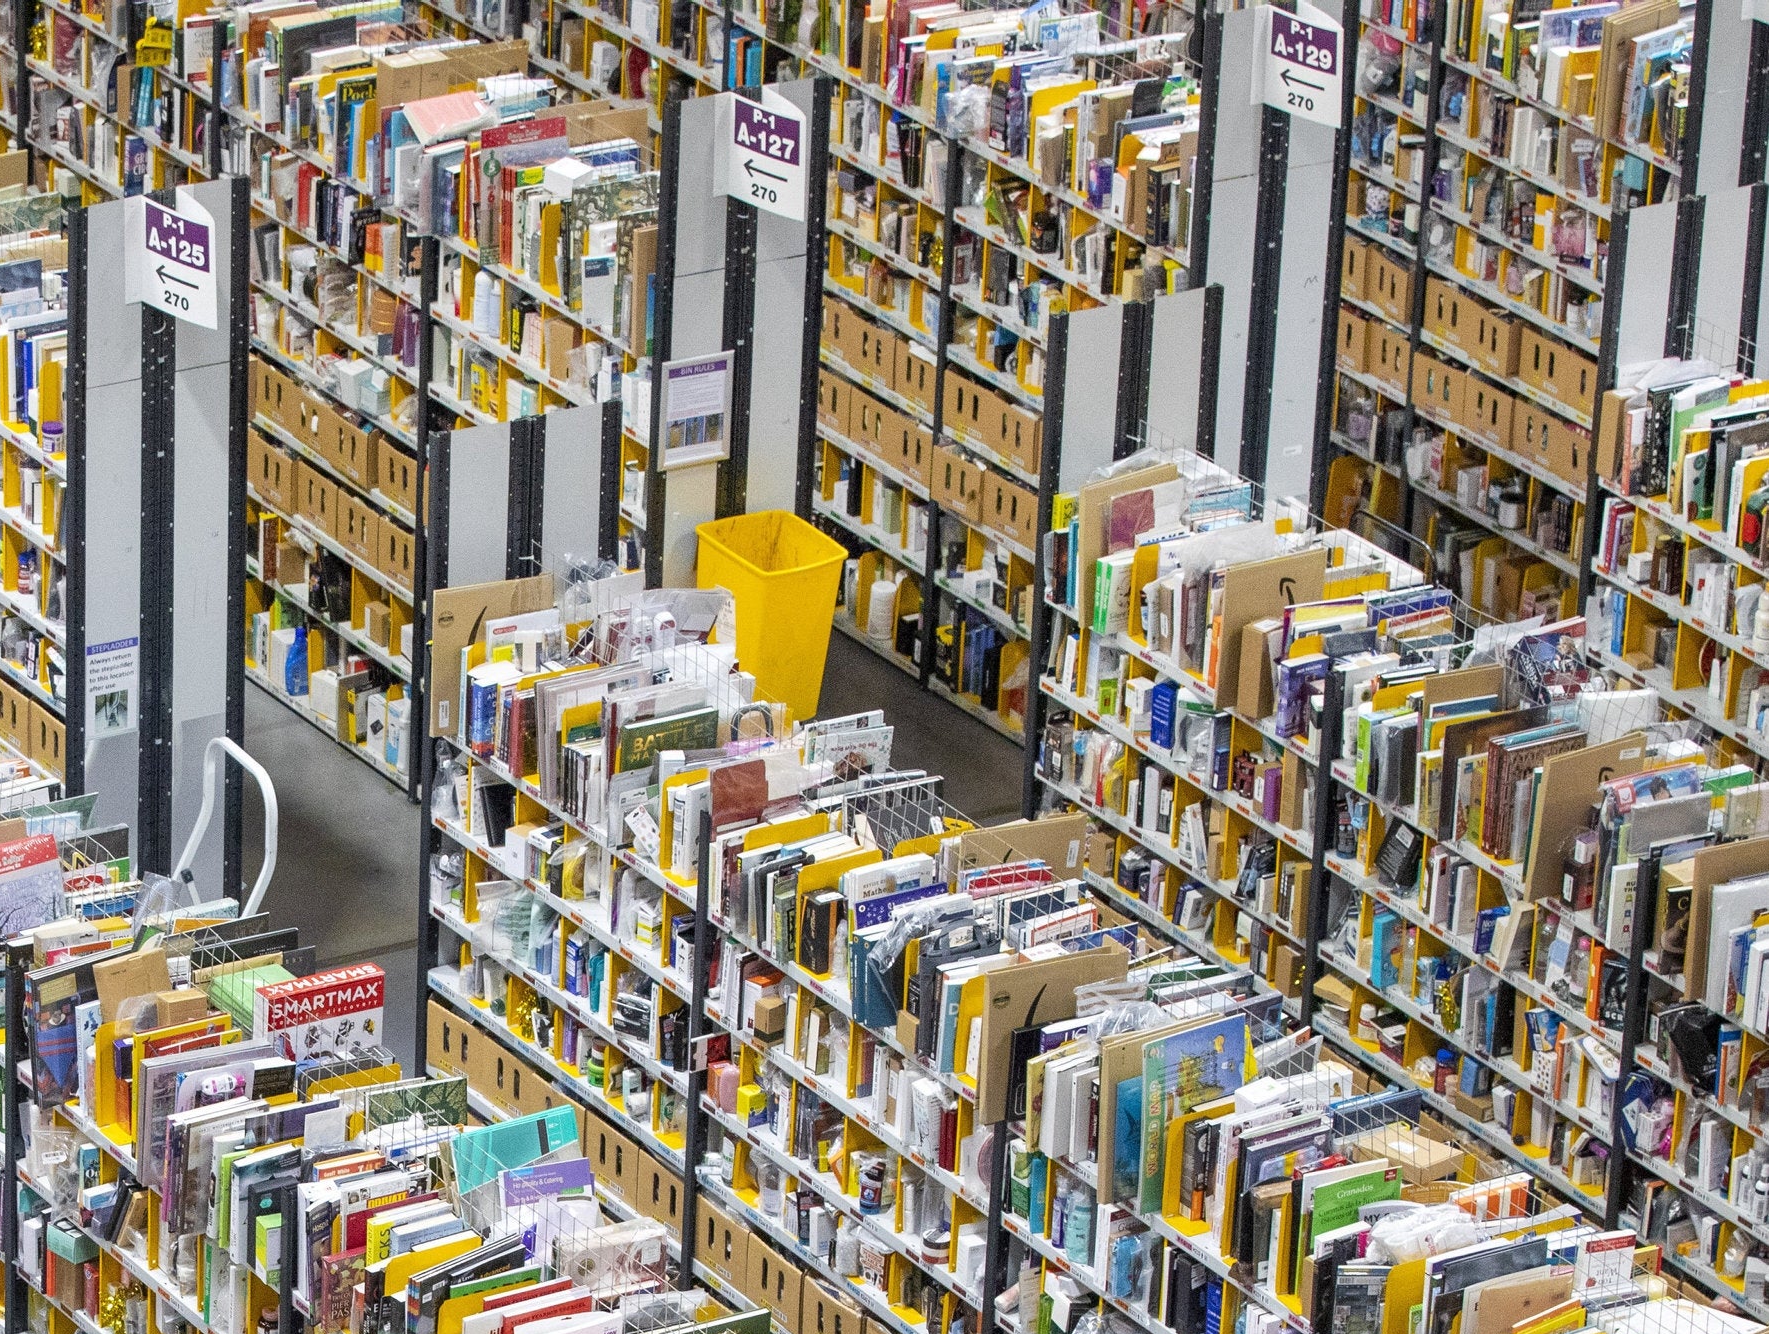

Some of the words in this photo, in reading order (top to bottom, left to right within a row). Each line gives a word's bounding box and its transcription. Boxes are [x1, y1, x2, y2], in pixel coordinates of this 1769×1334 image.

[1290, 20, 1313, 41] P-1
[1273, 34, 1333, 70] A-129
[1287, 92, 1315, 112] 270
[753, 108, 776, 130] P-1
[736, 122, 795, 160] A-127
[751, 183, 777, 204] 270
[163, 212, 184, 235] P-1
[148, 227, 205, 267] A-125
[164, 290, 190, 312] 270
[91, 640, 135, 654] STEPLADDER
[271, 983, 379, 1019] SMARTMAX
[1336, 1185, 1373, 1199] Granados
